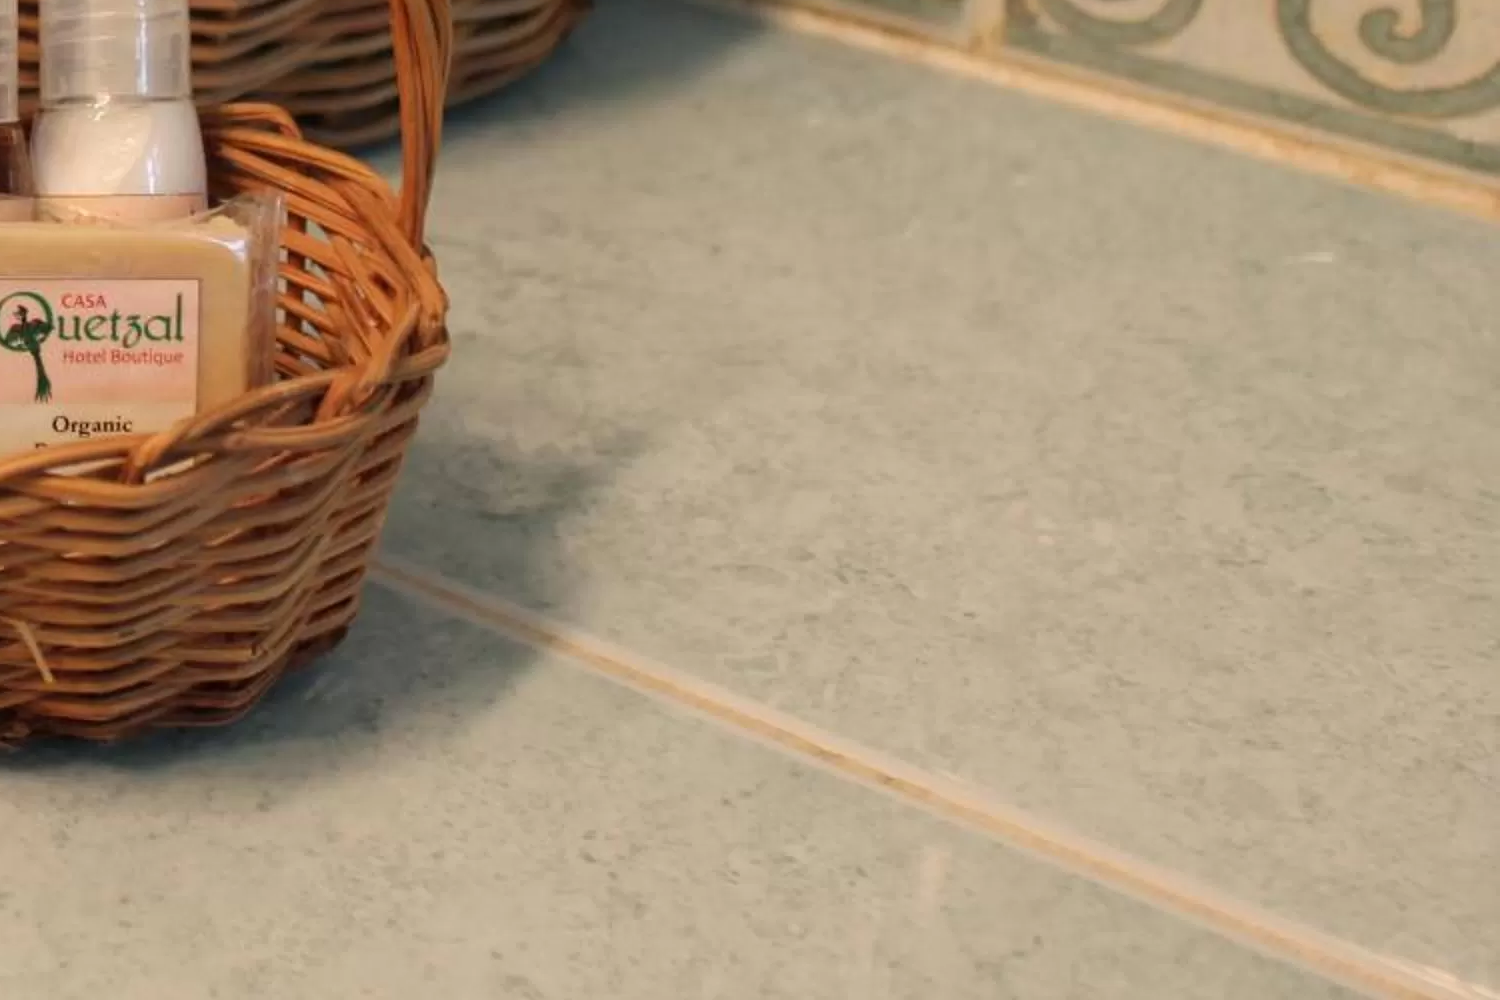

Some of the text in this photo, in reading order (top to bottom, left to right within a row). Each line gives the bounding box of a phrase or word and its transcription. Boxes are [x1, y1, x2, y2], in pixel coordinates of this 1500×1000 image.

[60, 293, 107, 309] CASA
[62, 348, 184, 367] Hotel Boutique
[51, 414, 133, 438] Organic
